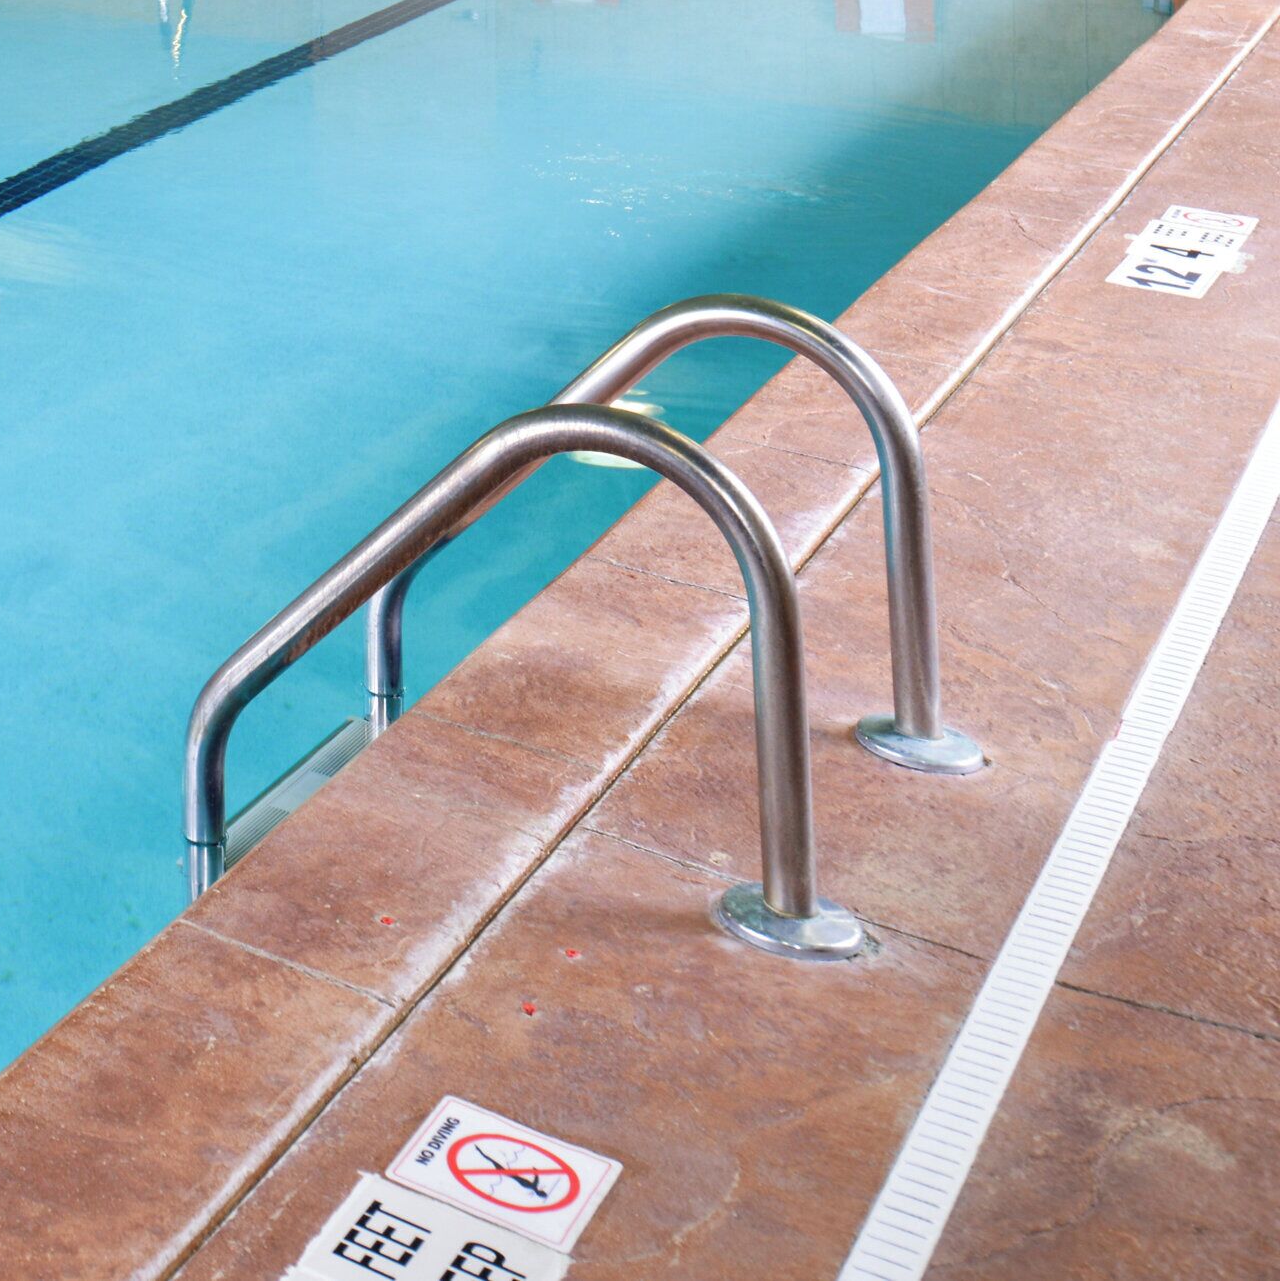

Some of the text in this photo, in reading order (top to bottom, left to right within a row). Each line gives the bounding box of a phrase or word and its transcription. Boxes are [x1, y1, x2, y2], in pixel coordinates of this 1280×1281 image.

[1149, 243, 1215, 260] 4
[415, 1115, 461, 1167] NO DIVING
[332, 1199, 432, 1281] FEET
